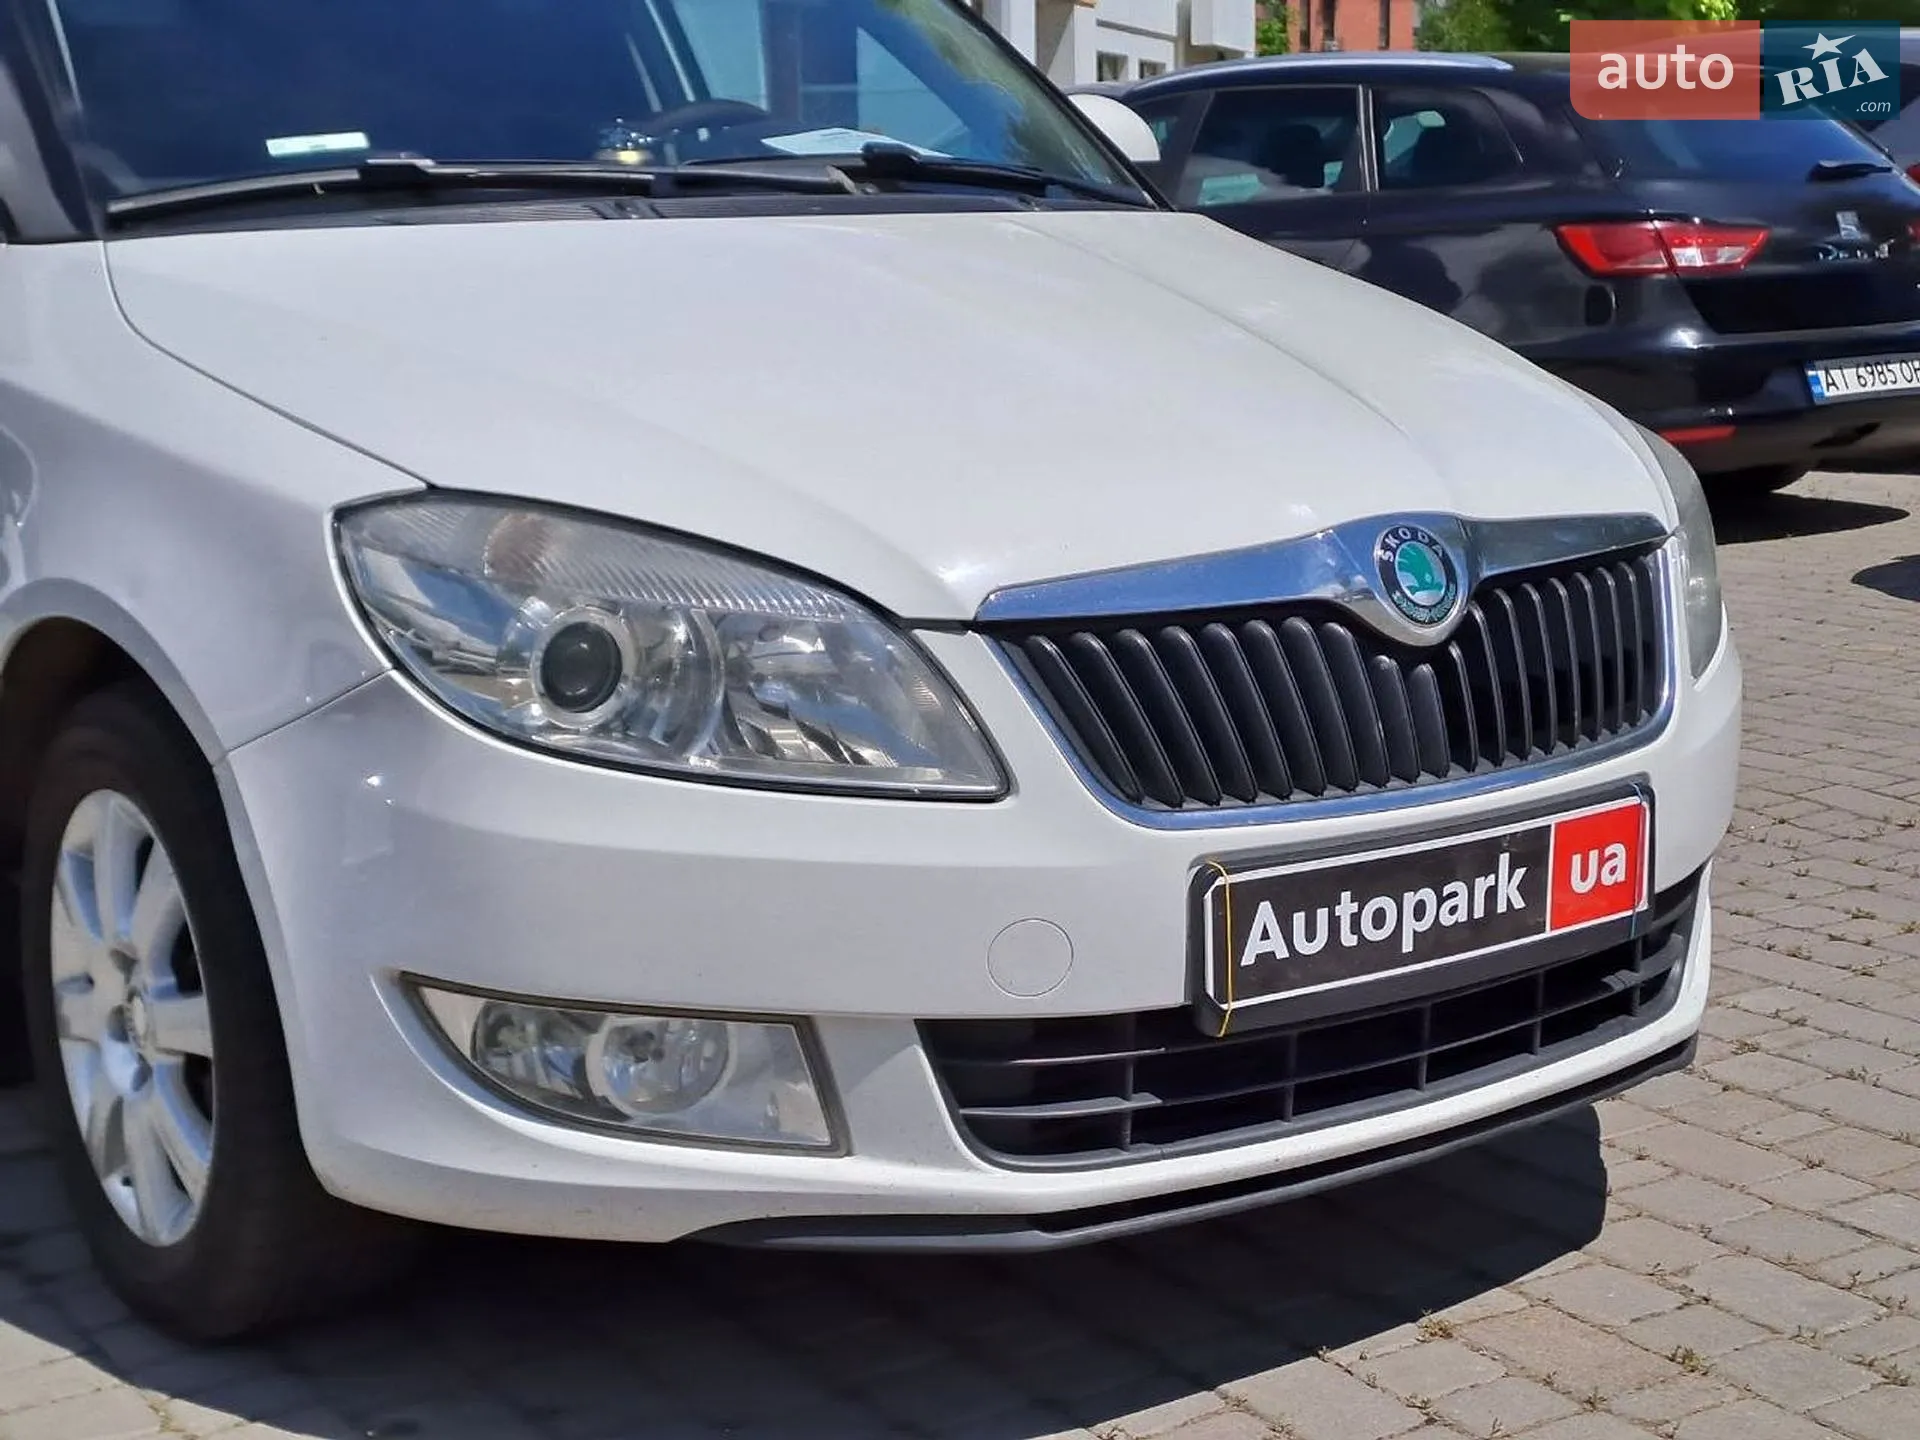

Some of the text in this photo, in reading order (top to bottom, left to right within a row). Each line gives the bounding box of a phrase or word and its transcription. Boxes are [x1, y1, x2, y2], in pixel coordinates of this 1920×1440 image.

[1824, 366, 1849, 392] AI
[1856, 362, 1898, 387] 6985
[1241, 842, 1627, 967] Autopark ua
